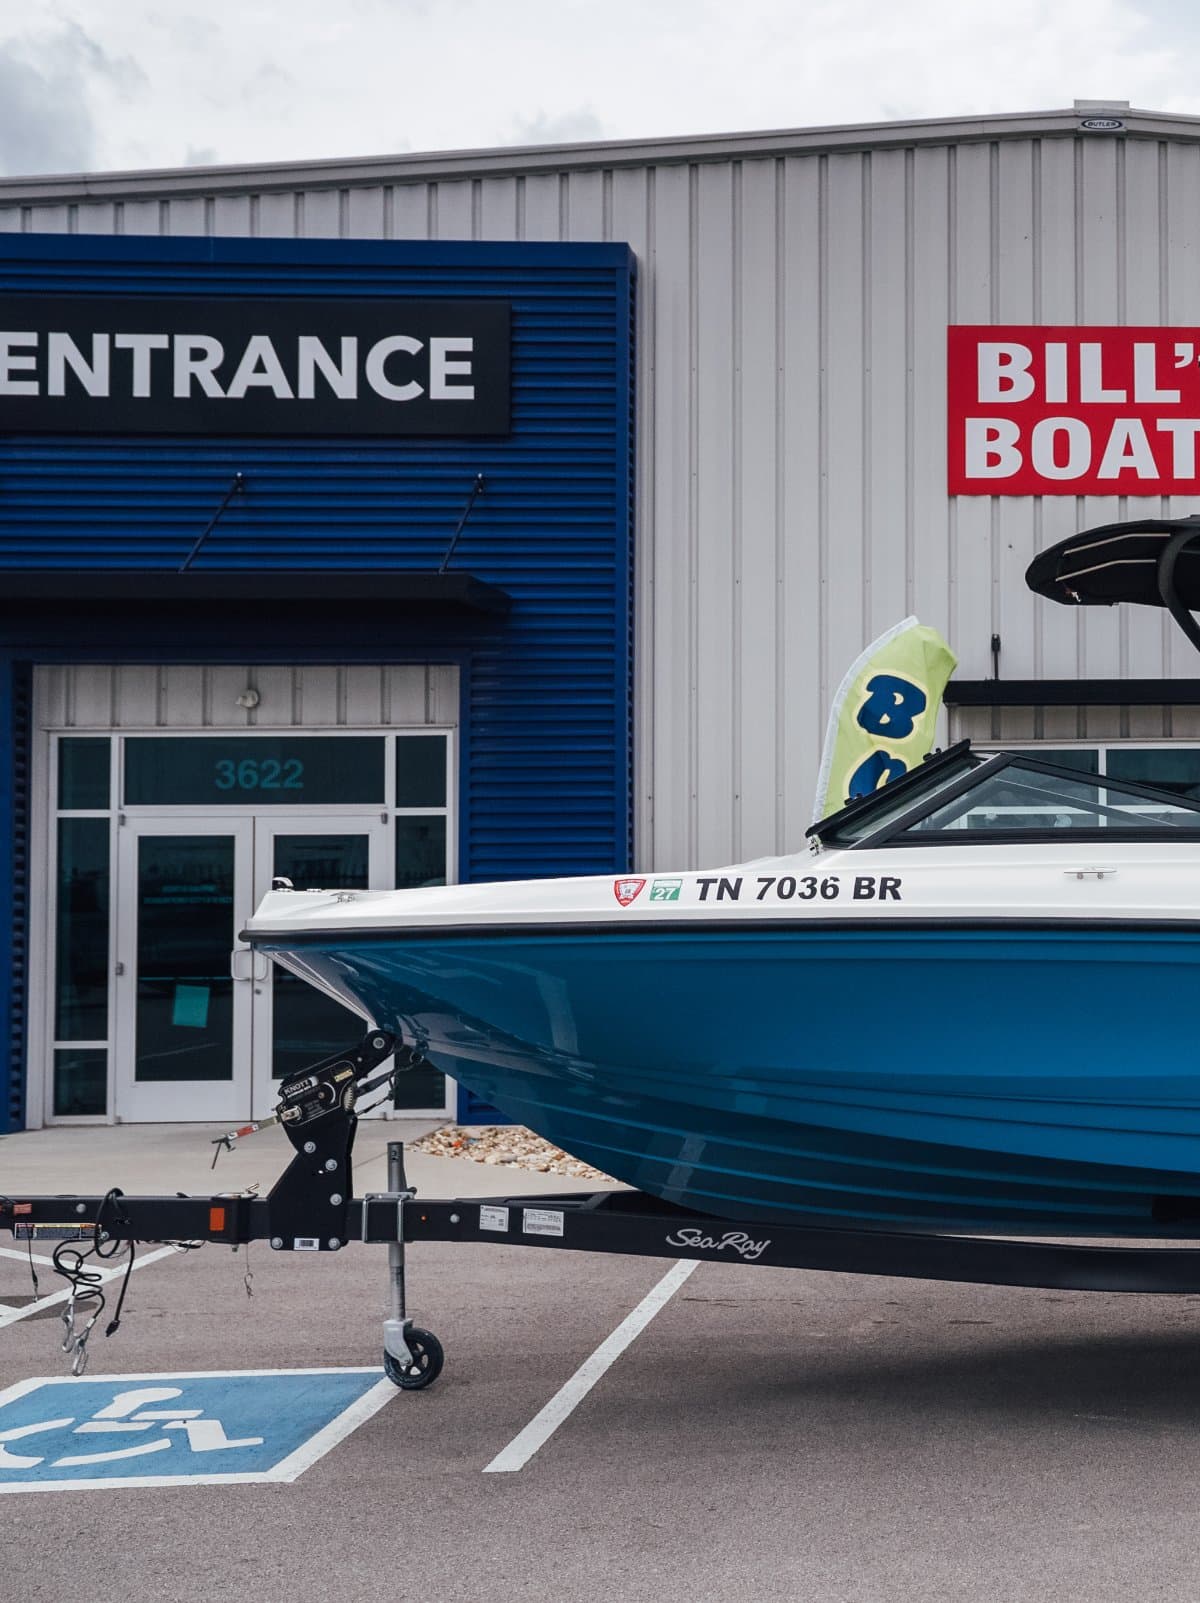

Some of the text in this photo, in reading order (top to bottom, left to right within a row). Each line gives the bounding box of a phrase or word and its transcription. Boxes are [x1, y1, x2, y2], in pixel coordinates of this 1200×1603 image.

[0, 331, 475, 401] ENTRANCE
[215, 759, 304, 789] 3622
[654, 888, 677, 900] 27
[696, 876, 902, 901] TN 7036 BR
[283, 1079, 310, 1096] KNOTT
[665, 1228, 771, 1259] Sea Ray
